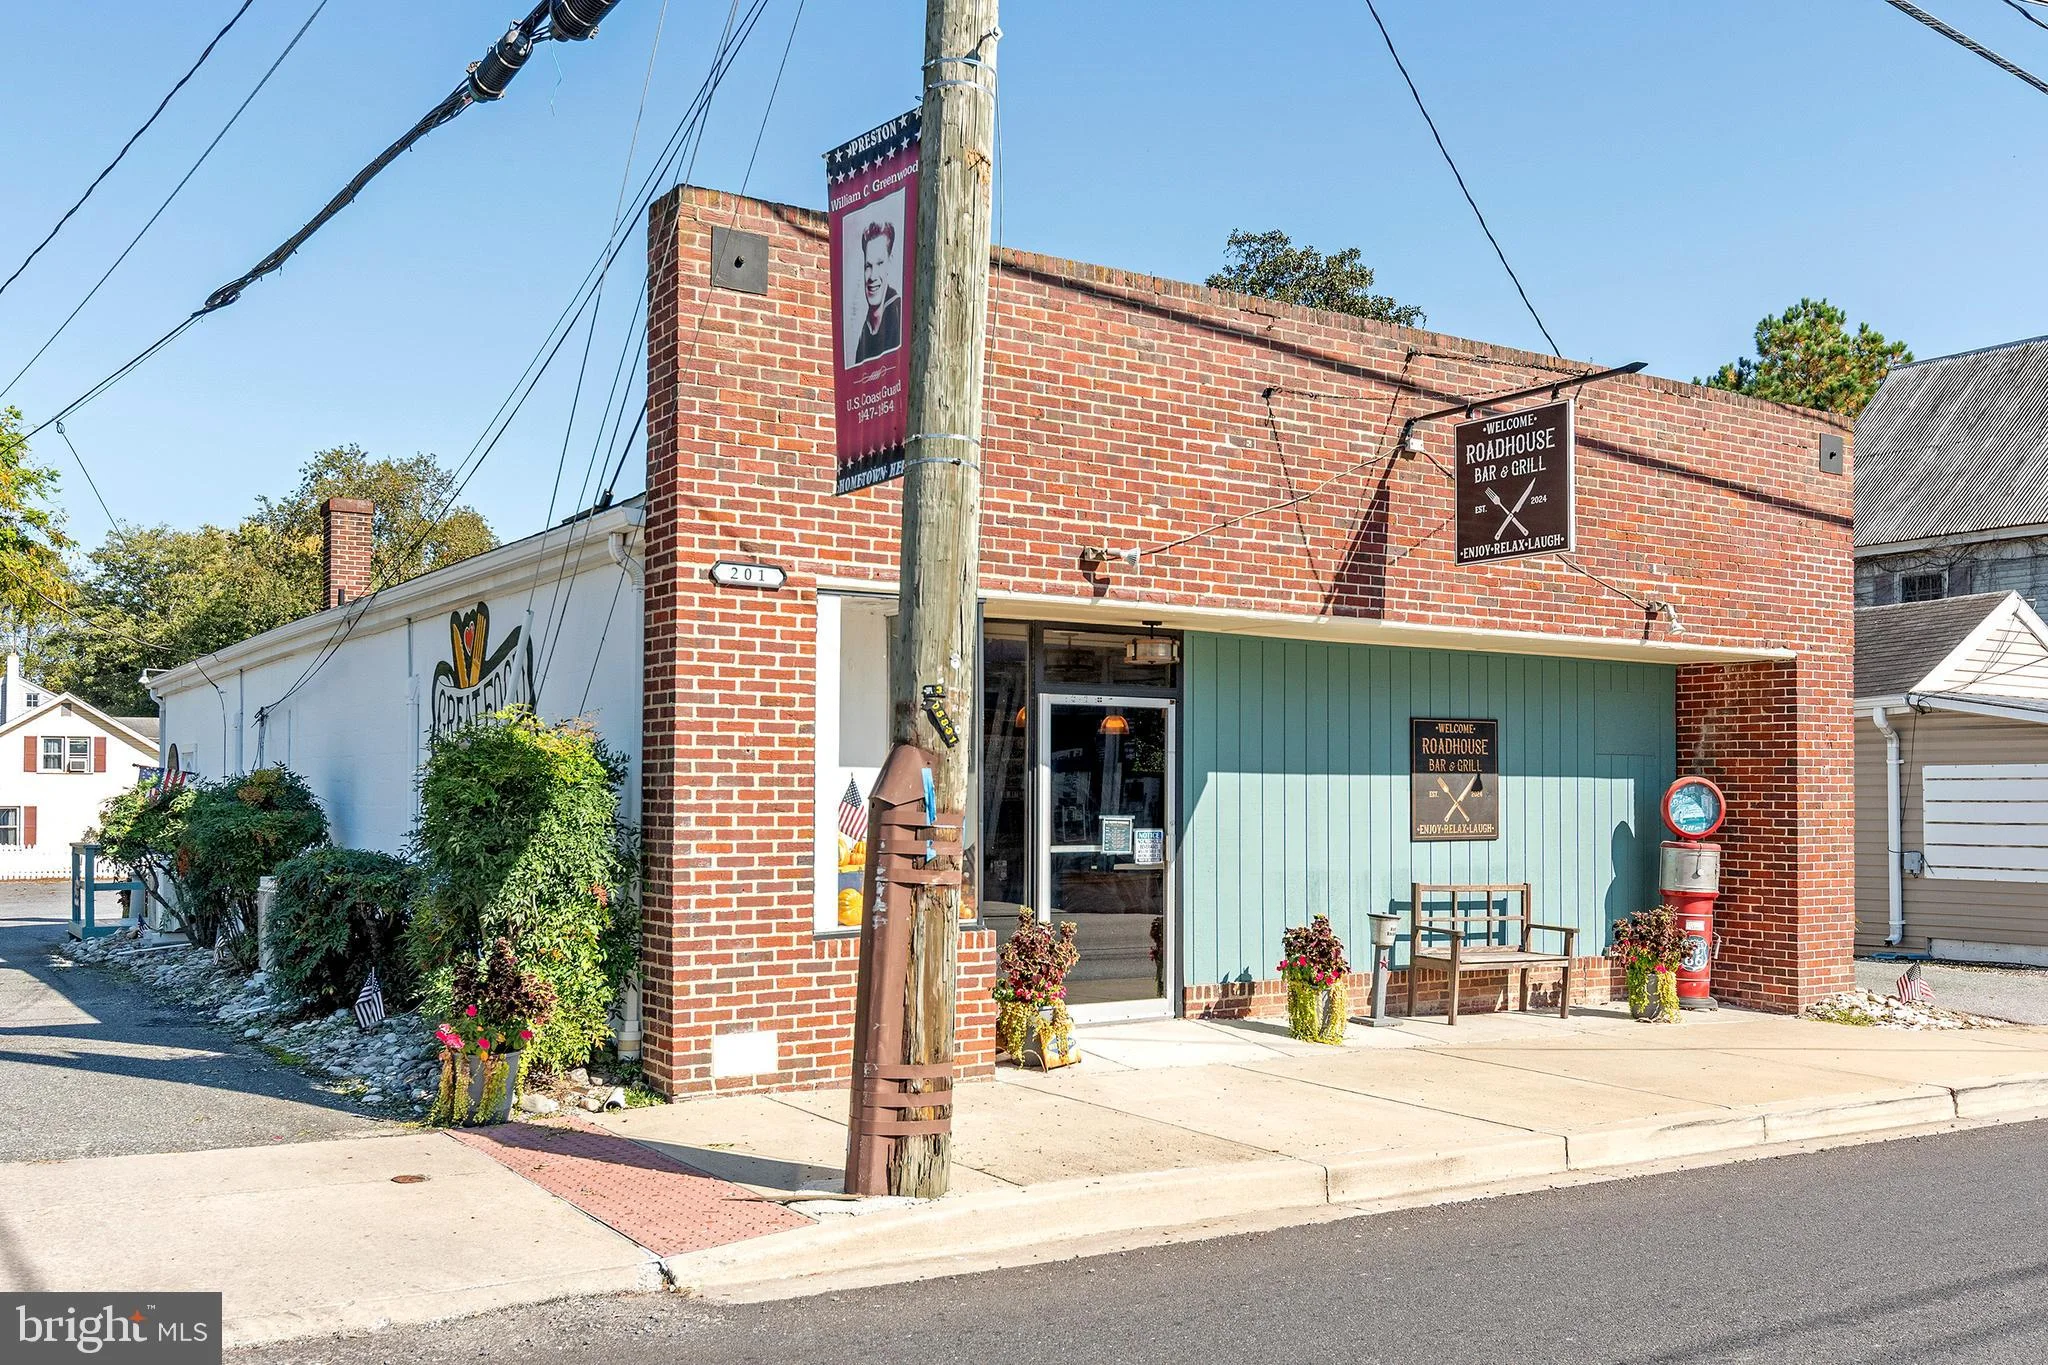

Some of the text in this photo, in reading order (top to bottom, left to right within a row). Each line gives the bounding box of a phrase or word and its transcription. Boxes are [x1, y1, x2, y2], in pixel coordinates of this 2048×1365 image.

[851, 120, 897, 156] PRESTON
[830, 191, 861, 212] William
[872, 160, 919, 192] Greenwood
[881, 379, 902, 398] Guad
[1486, 414, 1534, 435] WELCOME
[1466, 427, 1556, 465] ROADHOUSE
[839, 466, 886, 493] HOMETOWN
[1474, 456, 1546, 484] BAR & GRILL
[1474, 495, 1547, 514] EST. 2024
[730, 567, 765, 582] 201
[437, 688, 481, 735] GREAT
[1438, 723, 1474, 734] WELCOME
[1422, 737, 1489, 755] ROADHOUSE
[1429, 758, 1482, 772] BAR & GRILL
